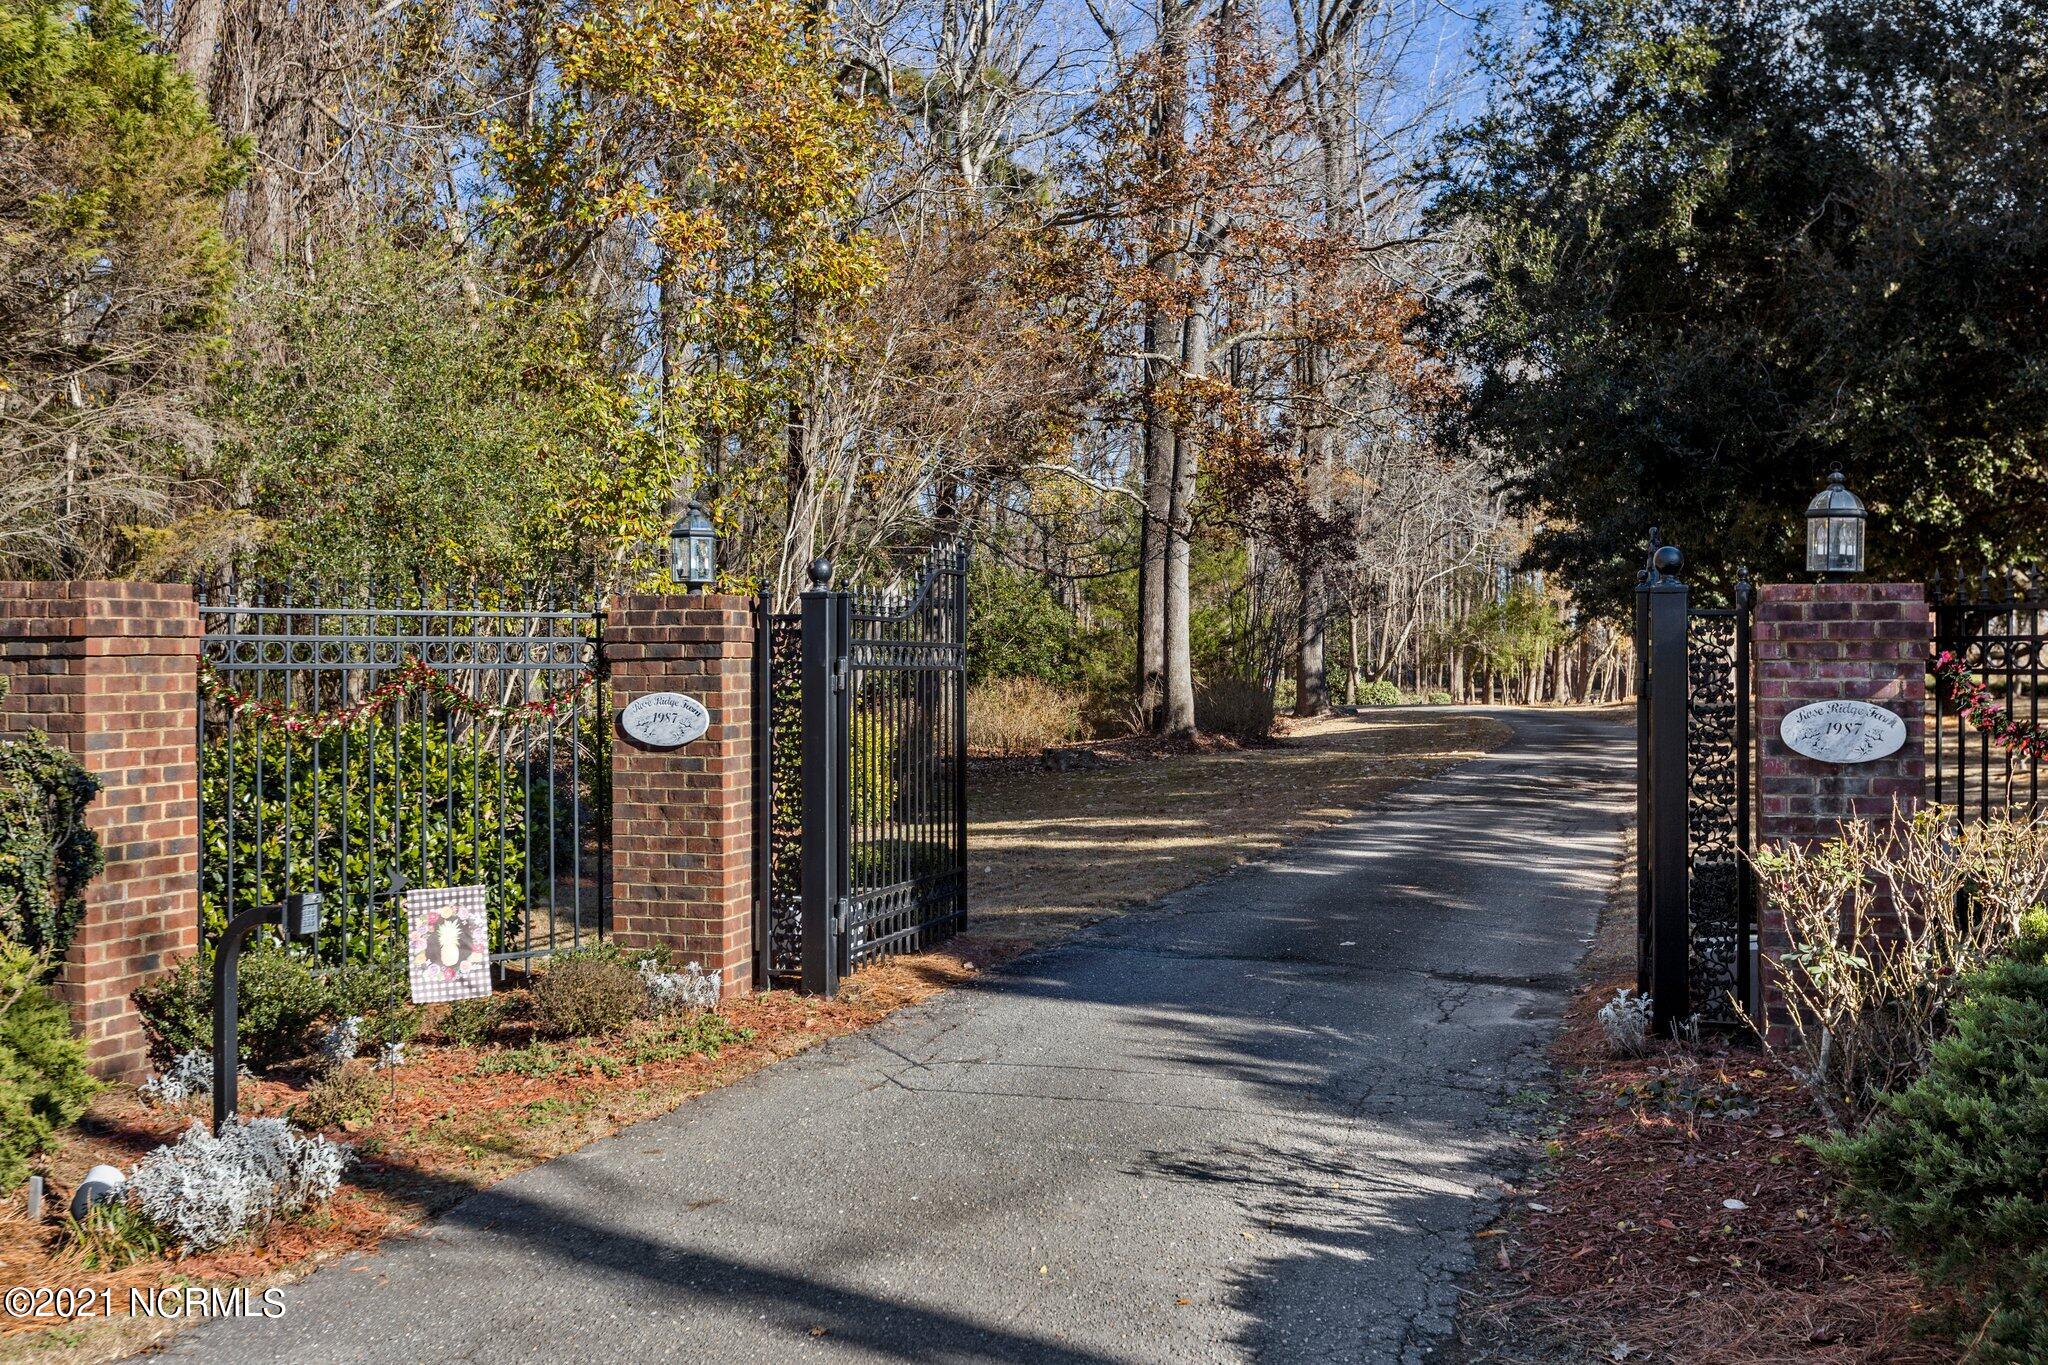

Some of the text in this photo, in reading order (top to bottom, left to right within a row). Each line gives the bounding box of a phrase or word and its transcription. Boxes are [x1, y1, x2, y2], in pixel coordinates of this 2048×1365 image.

[652, 712, 678, 724] 1987
[1796, 707, 1824, 723] Rose
[1826, 702, 1864, 716] Ridge
[1825, 722, 1863, 735] 1987
